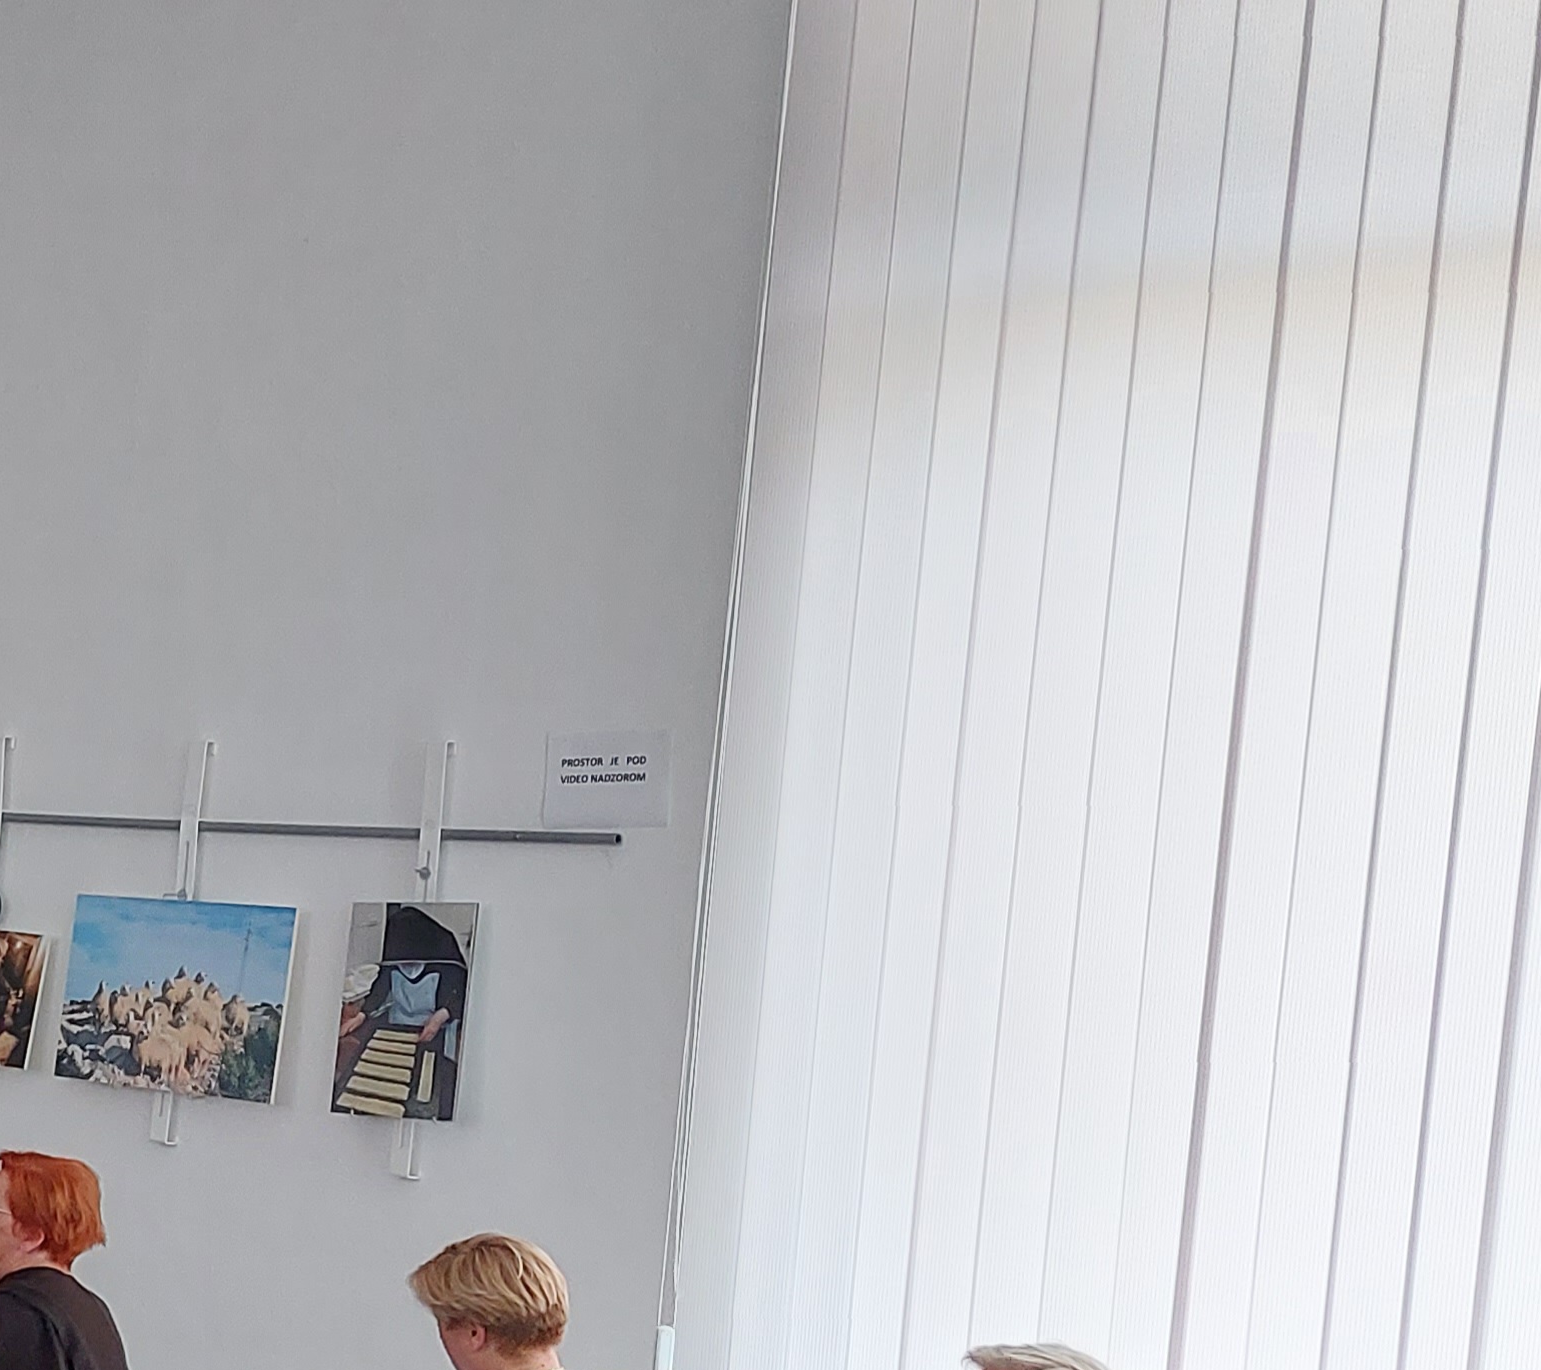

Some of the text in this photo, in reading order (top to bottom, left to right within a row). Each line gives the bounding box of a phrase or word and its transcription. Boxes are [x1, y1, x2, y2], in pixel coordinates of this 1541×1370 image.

[561, 755, 647, 768] PROSTOR JE POD
[560, 772, 647, 784] VIDEO NADZOROM
